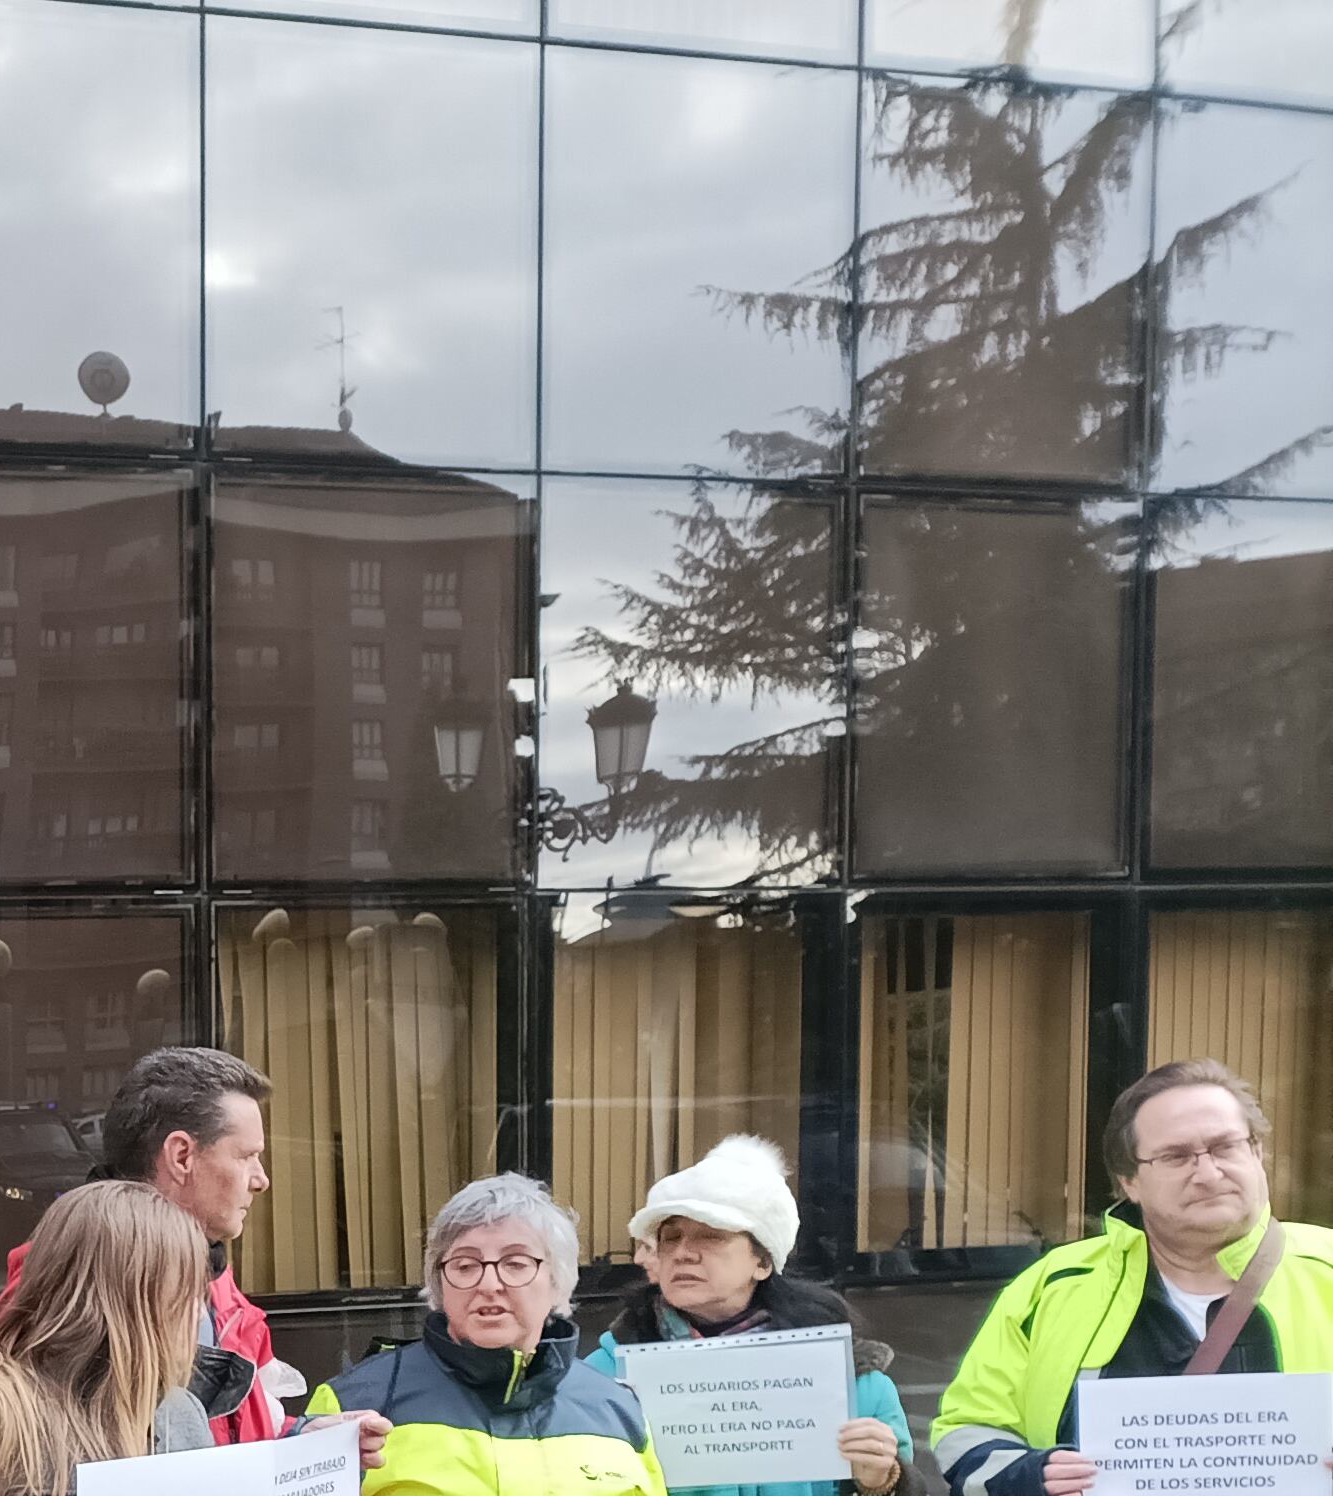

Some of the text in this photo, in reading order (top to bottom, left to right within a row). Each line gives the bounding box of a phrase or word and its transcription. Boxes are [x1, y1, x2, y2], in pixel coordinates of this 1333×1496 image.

[660, 1377, 814, 1395] LOS USUARIOS PAGAN
[710, 1402, 728, 1413] AL
[661, 1418, 816, 1436] PERO EL ERA NO PAGA
[1121, 1410, 1289, 1427] LAS DEUDAS DEL ERA
[684, 1439, 794, 1455] AL TRANSPORTE
[1114, 1433, 1297, 1450] CON EL TRASPORTE NO
[1179, 1456, 1198, 1469] LA
[1202, 1453, 1318, 1468] CONTINUIDAD
[278, 1469, 297, 1485] DEJA
[298, 1465, 313, 1479] SIN
[313, 1455, 346, 1474] TRABAJO
[1135, 1475, 1276, 1491] DE LOS SERVICIOS
